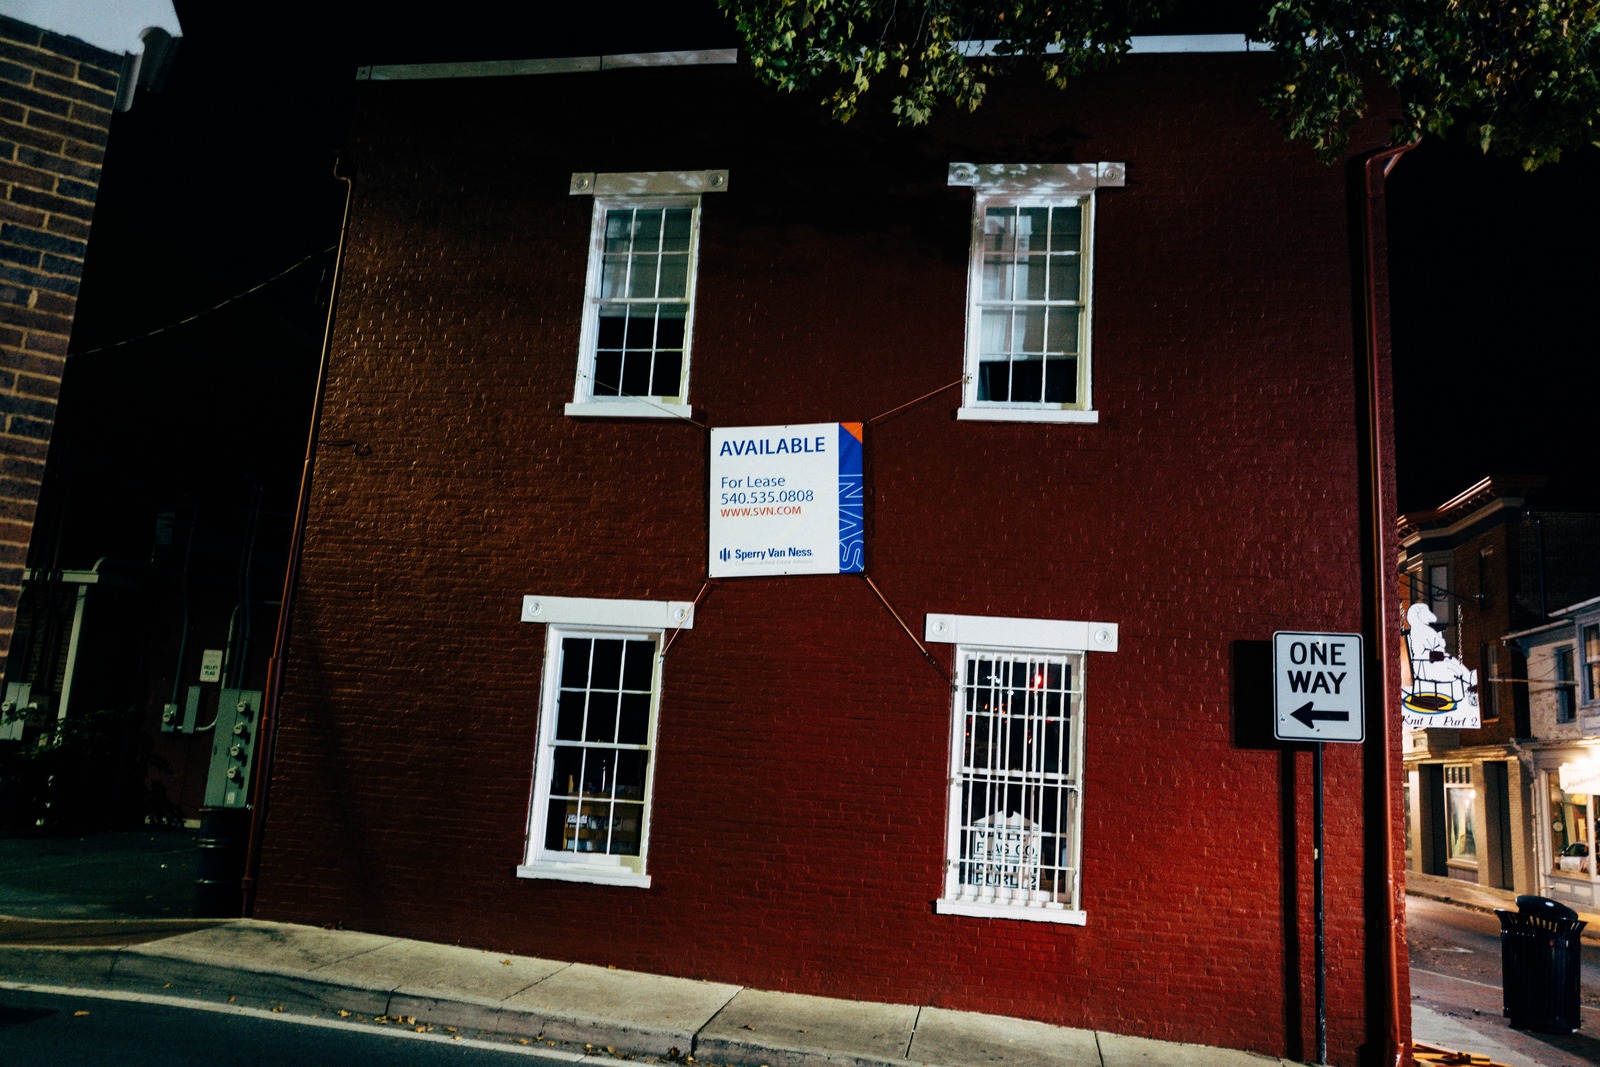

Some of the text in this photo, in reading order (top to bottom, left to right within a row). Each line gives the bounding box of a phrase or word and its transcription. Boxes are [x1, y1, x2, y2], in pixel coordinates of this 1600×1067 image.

[719, 436, 825, 457] AVAILABLE
[721, 475, 786, 489] For Lease
[720, 489, 814, 505] 540.535.0808
[720, 505, 802, 518] WWW.SVN.COM
[735, 547, 812, 561] Sperry Van Ness
[1290, 641, 1346, 666] ONE
[1287, 670, 1348, 694] WAY
[1402, 715, 1424, 726] Knit
[1443, 716, 1466, 727] Purl
[1471, 717, 1478, 727] 2
